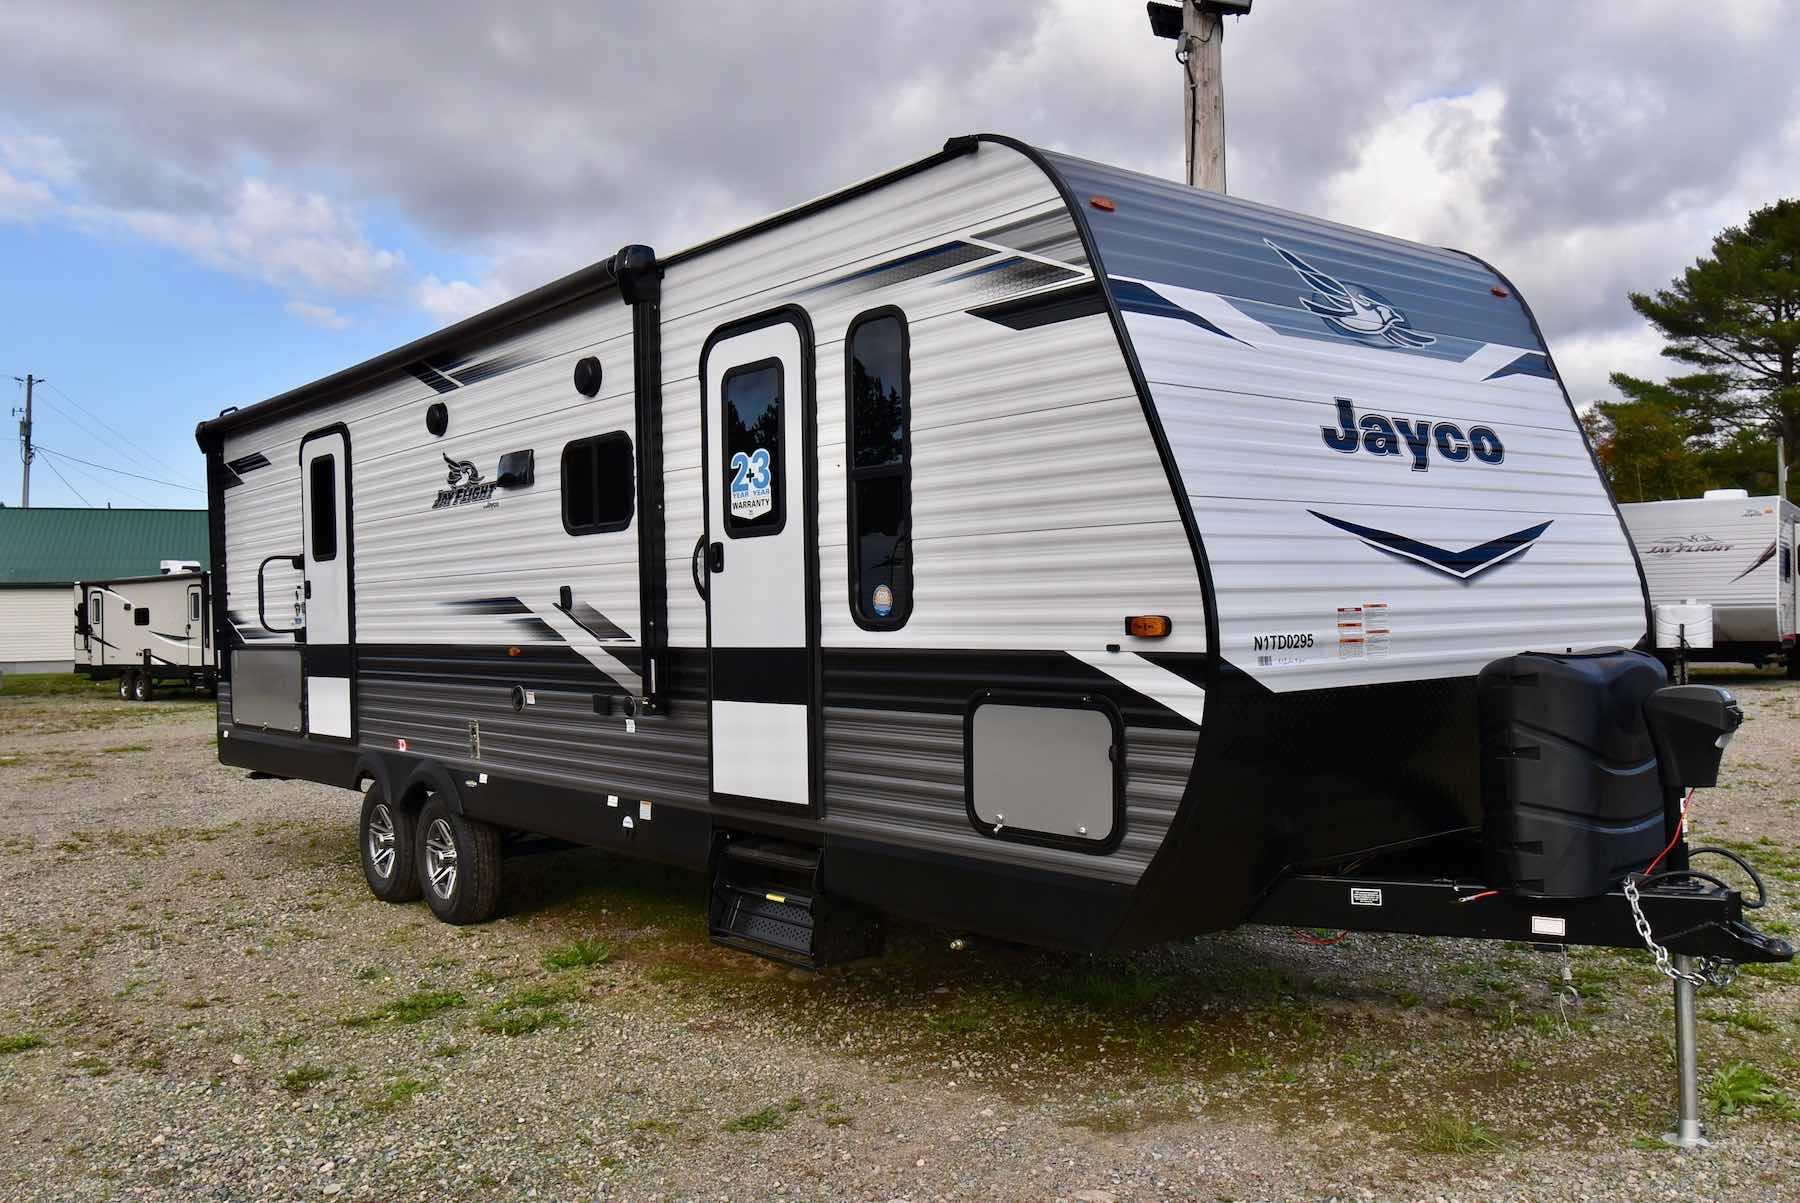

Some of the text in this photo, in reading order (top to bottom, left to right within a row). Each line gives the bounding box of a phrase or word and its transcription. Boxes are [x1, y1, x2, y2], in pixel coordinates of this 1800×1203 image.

[1320, 397, 1505, 472] Jayco
[432, 485, 497, 509] JAY FLIGHT
[753, 488, 770, 496] YEAR
[732, 498, 770, 510] WARRANTY
[1253, 633, 1314, 651] N1TD0295
